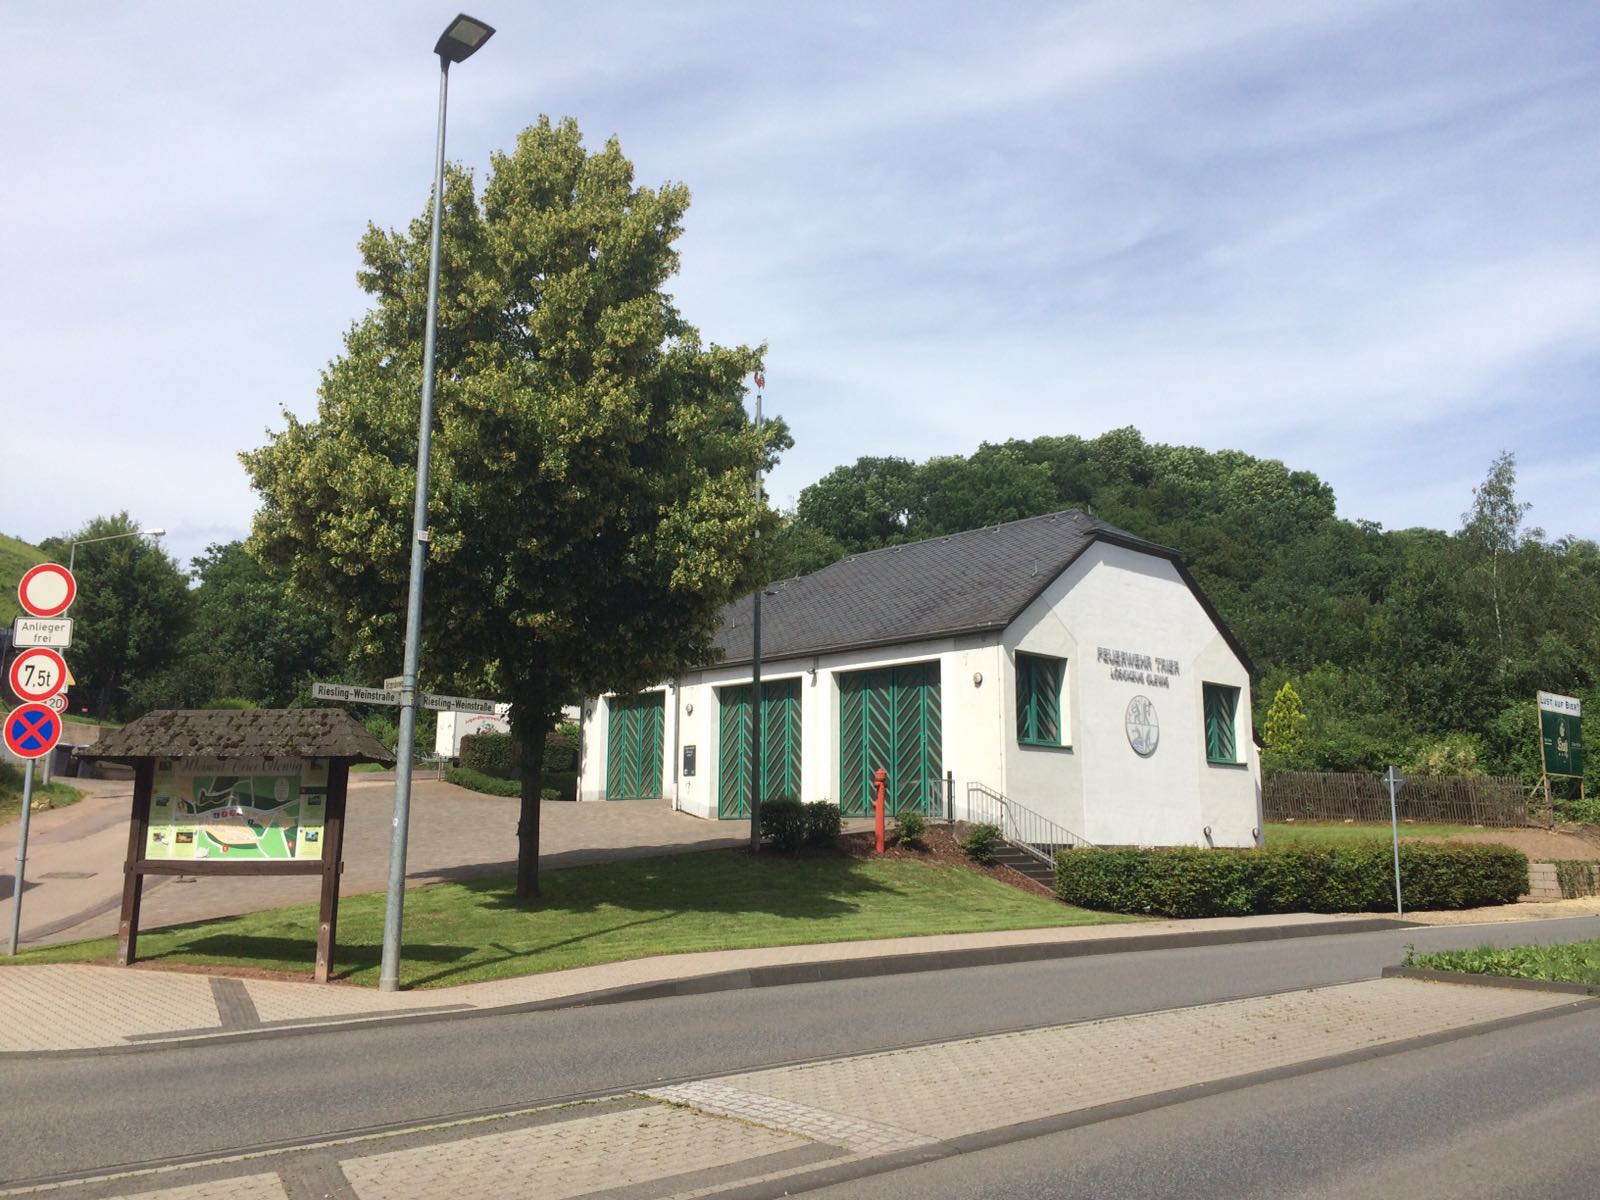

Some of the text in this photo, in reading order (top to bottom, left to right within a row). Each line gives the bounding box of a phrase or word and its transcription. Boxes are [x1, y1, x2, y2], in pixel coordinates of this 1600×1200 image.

[21, 622, 65, 633] Anlieger
[33, 634, 51, 643] frei
[1097, 646, 1180, 677] FEUERWEHR TRIER
[24, 664, 51, 687] 7,5t
[318, 685, 395, 701] Riesling-Weinstraße
[48, 698, 63, 709] 20
[423, 696, 492, 712] Riesling-Weinstraße
